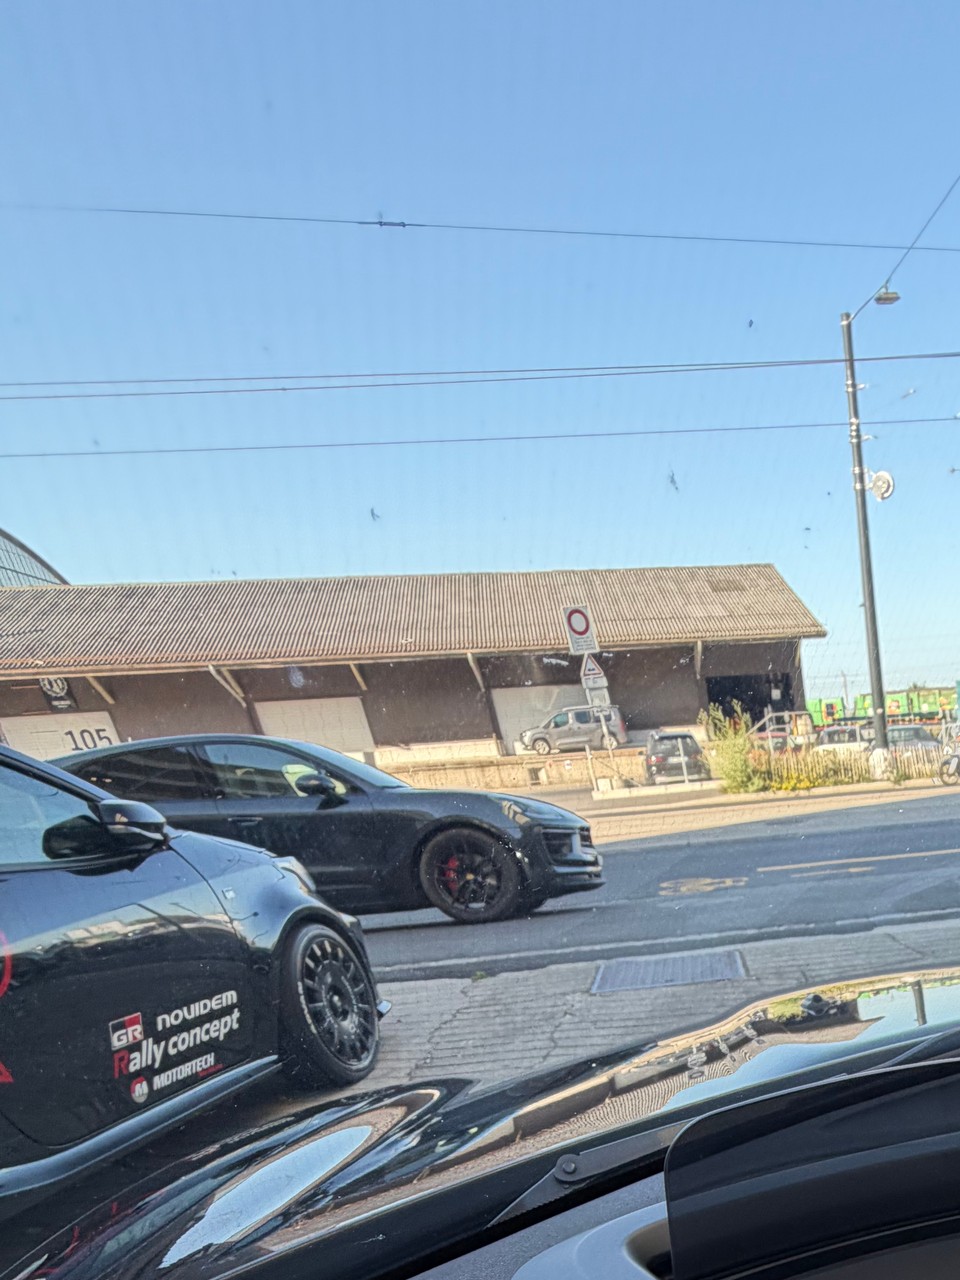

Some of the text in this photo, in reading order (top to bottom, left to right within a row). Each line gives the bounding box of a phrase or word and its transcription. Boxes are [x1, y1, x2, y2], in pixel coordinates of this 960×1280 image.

[64, 728, 113, 751] 105
[112, 1024, 143, 1048] GR
[113, 1008, 240, 1079] Rally concept
[153, 1052, 215, 1091] MOTORTECH
